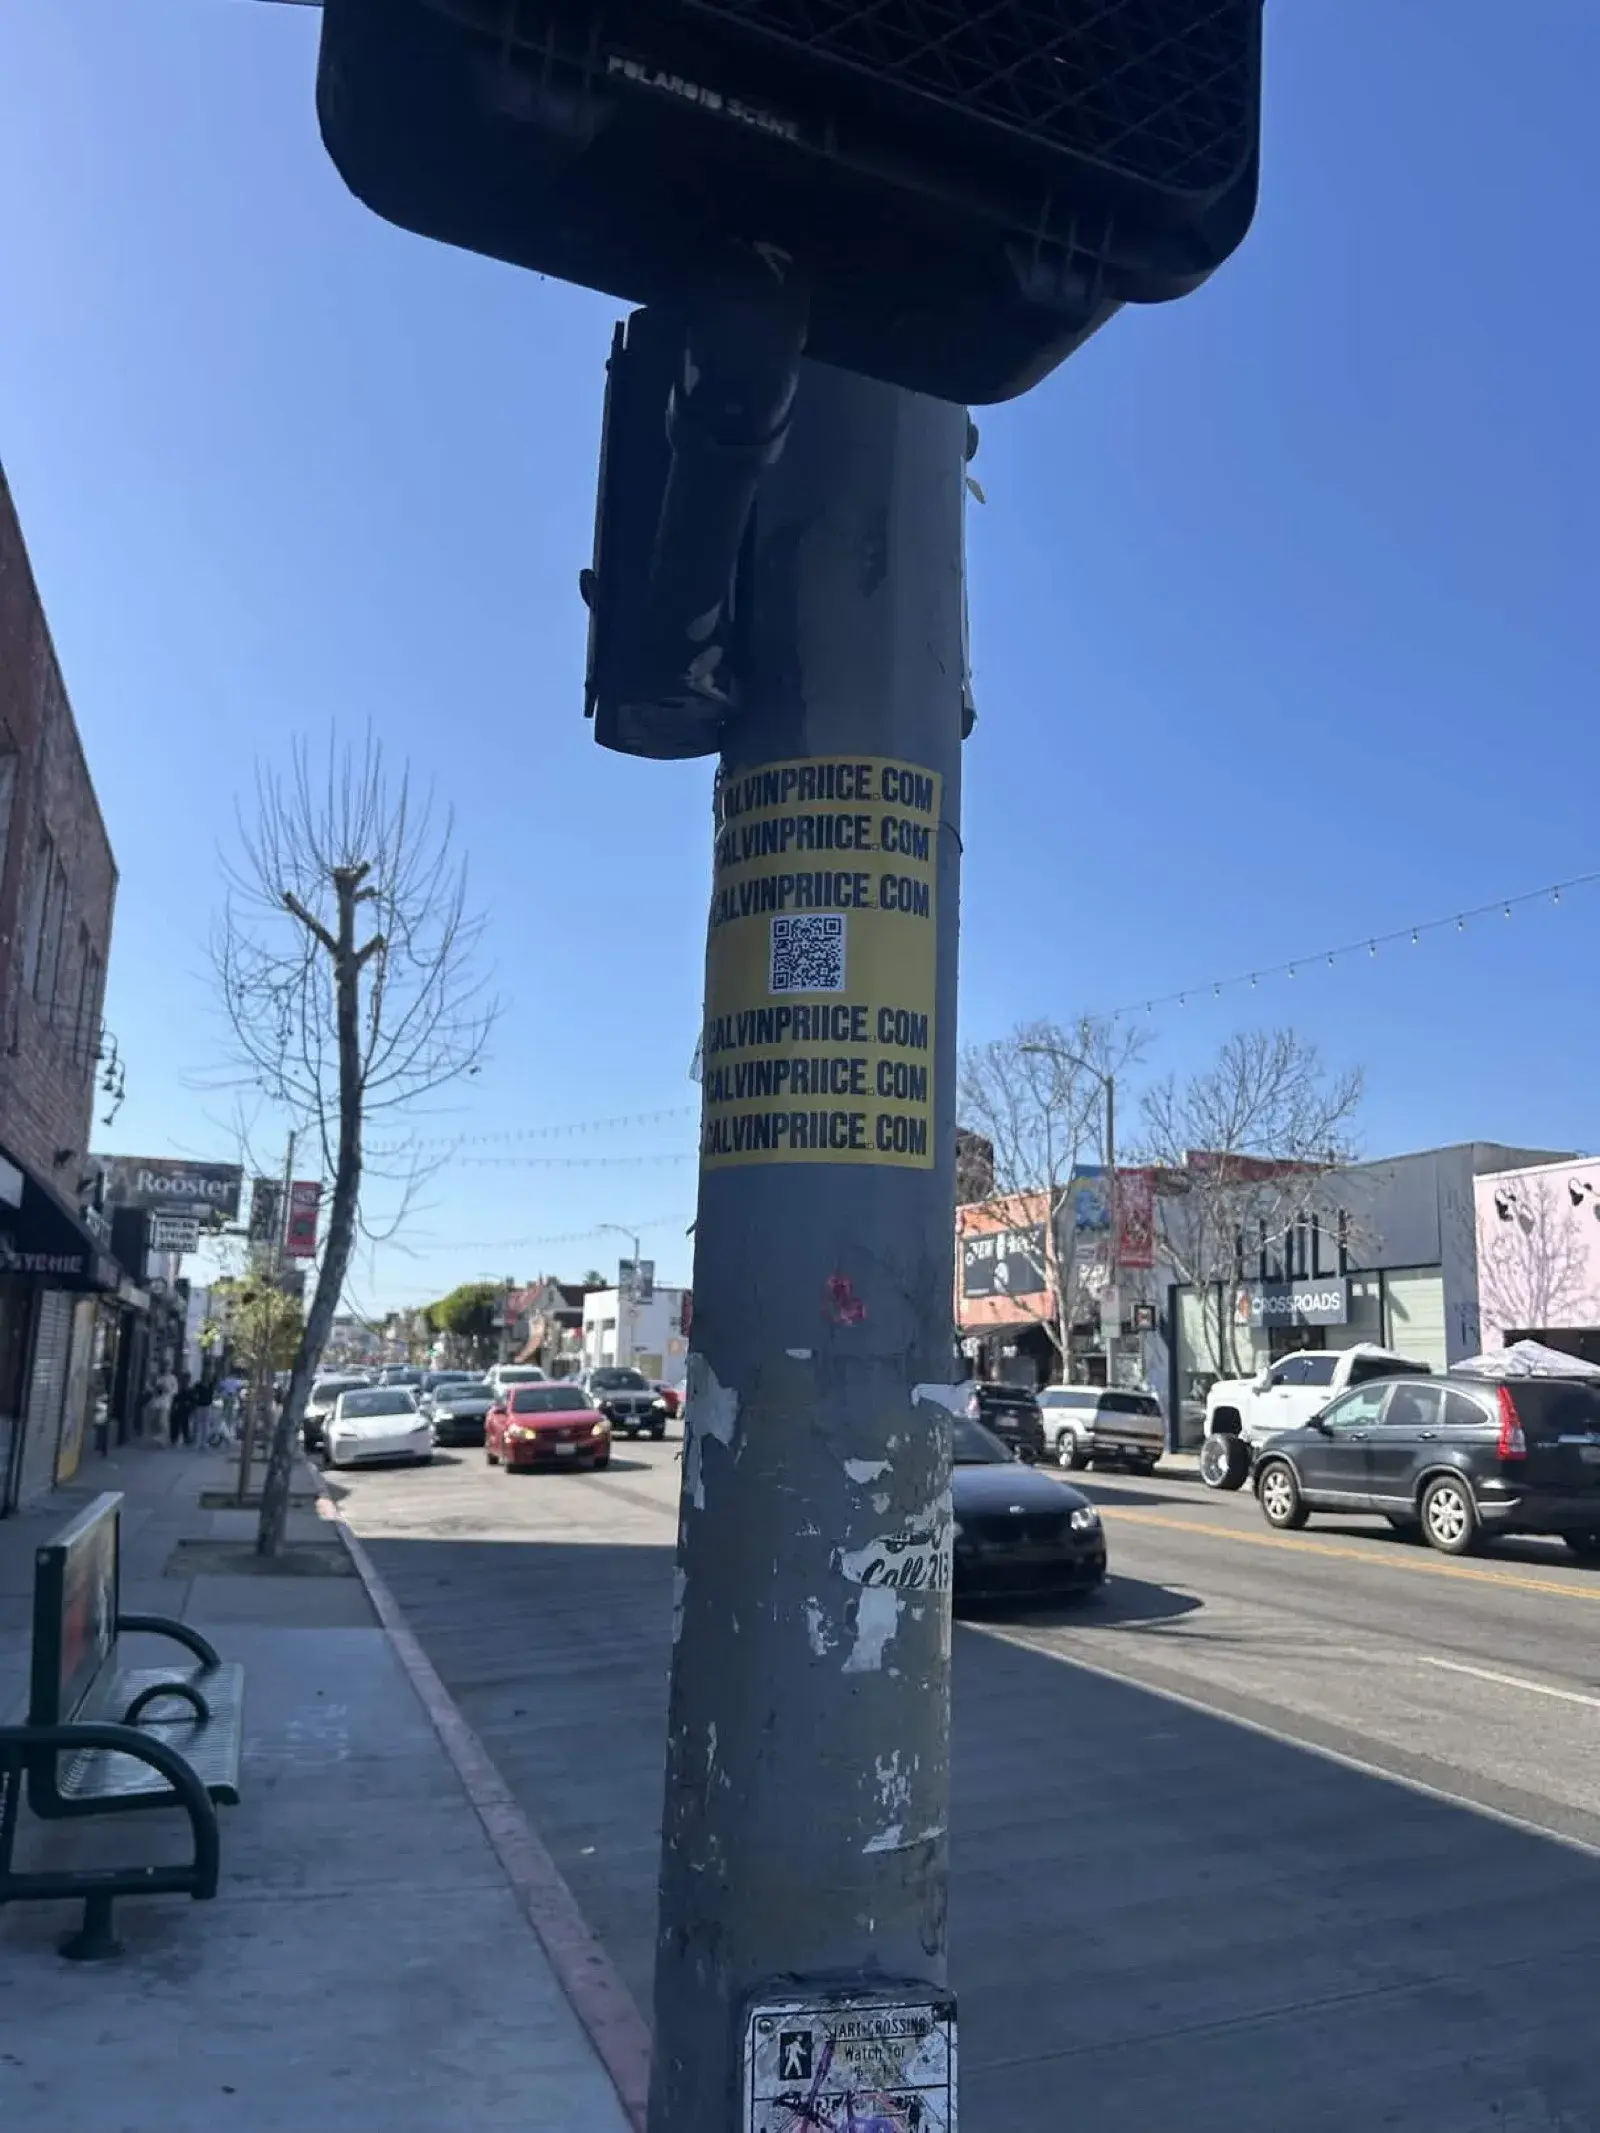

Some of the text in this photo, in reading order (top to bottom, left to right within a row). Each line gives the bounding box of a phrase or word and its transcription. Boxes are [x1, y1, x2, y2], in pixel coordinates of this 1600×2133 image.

[723, 764, 934, 819] ALVINPRIICE.COM
[4, 1253, 82, 1273] SYCHIC
[1252, 1292, 1340, 1314] CROSSROADS
[861, 1556, 927, 1588] Call
